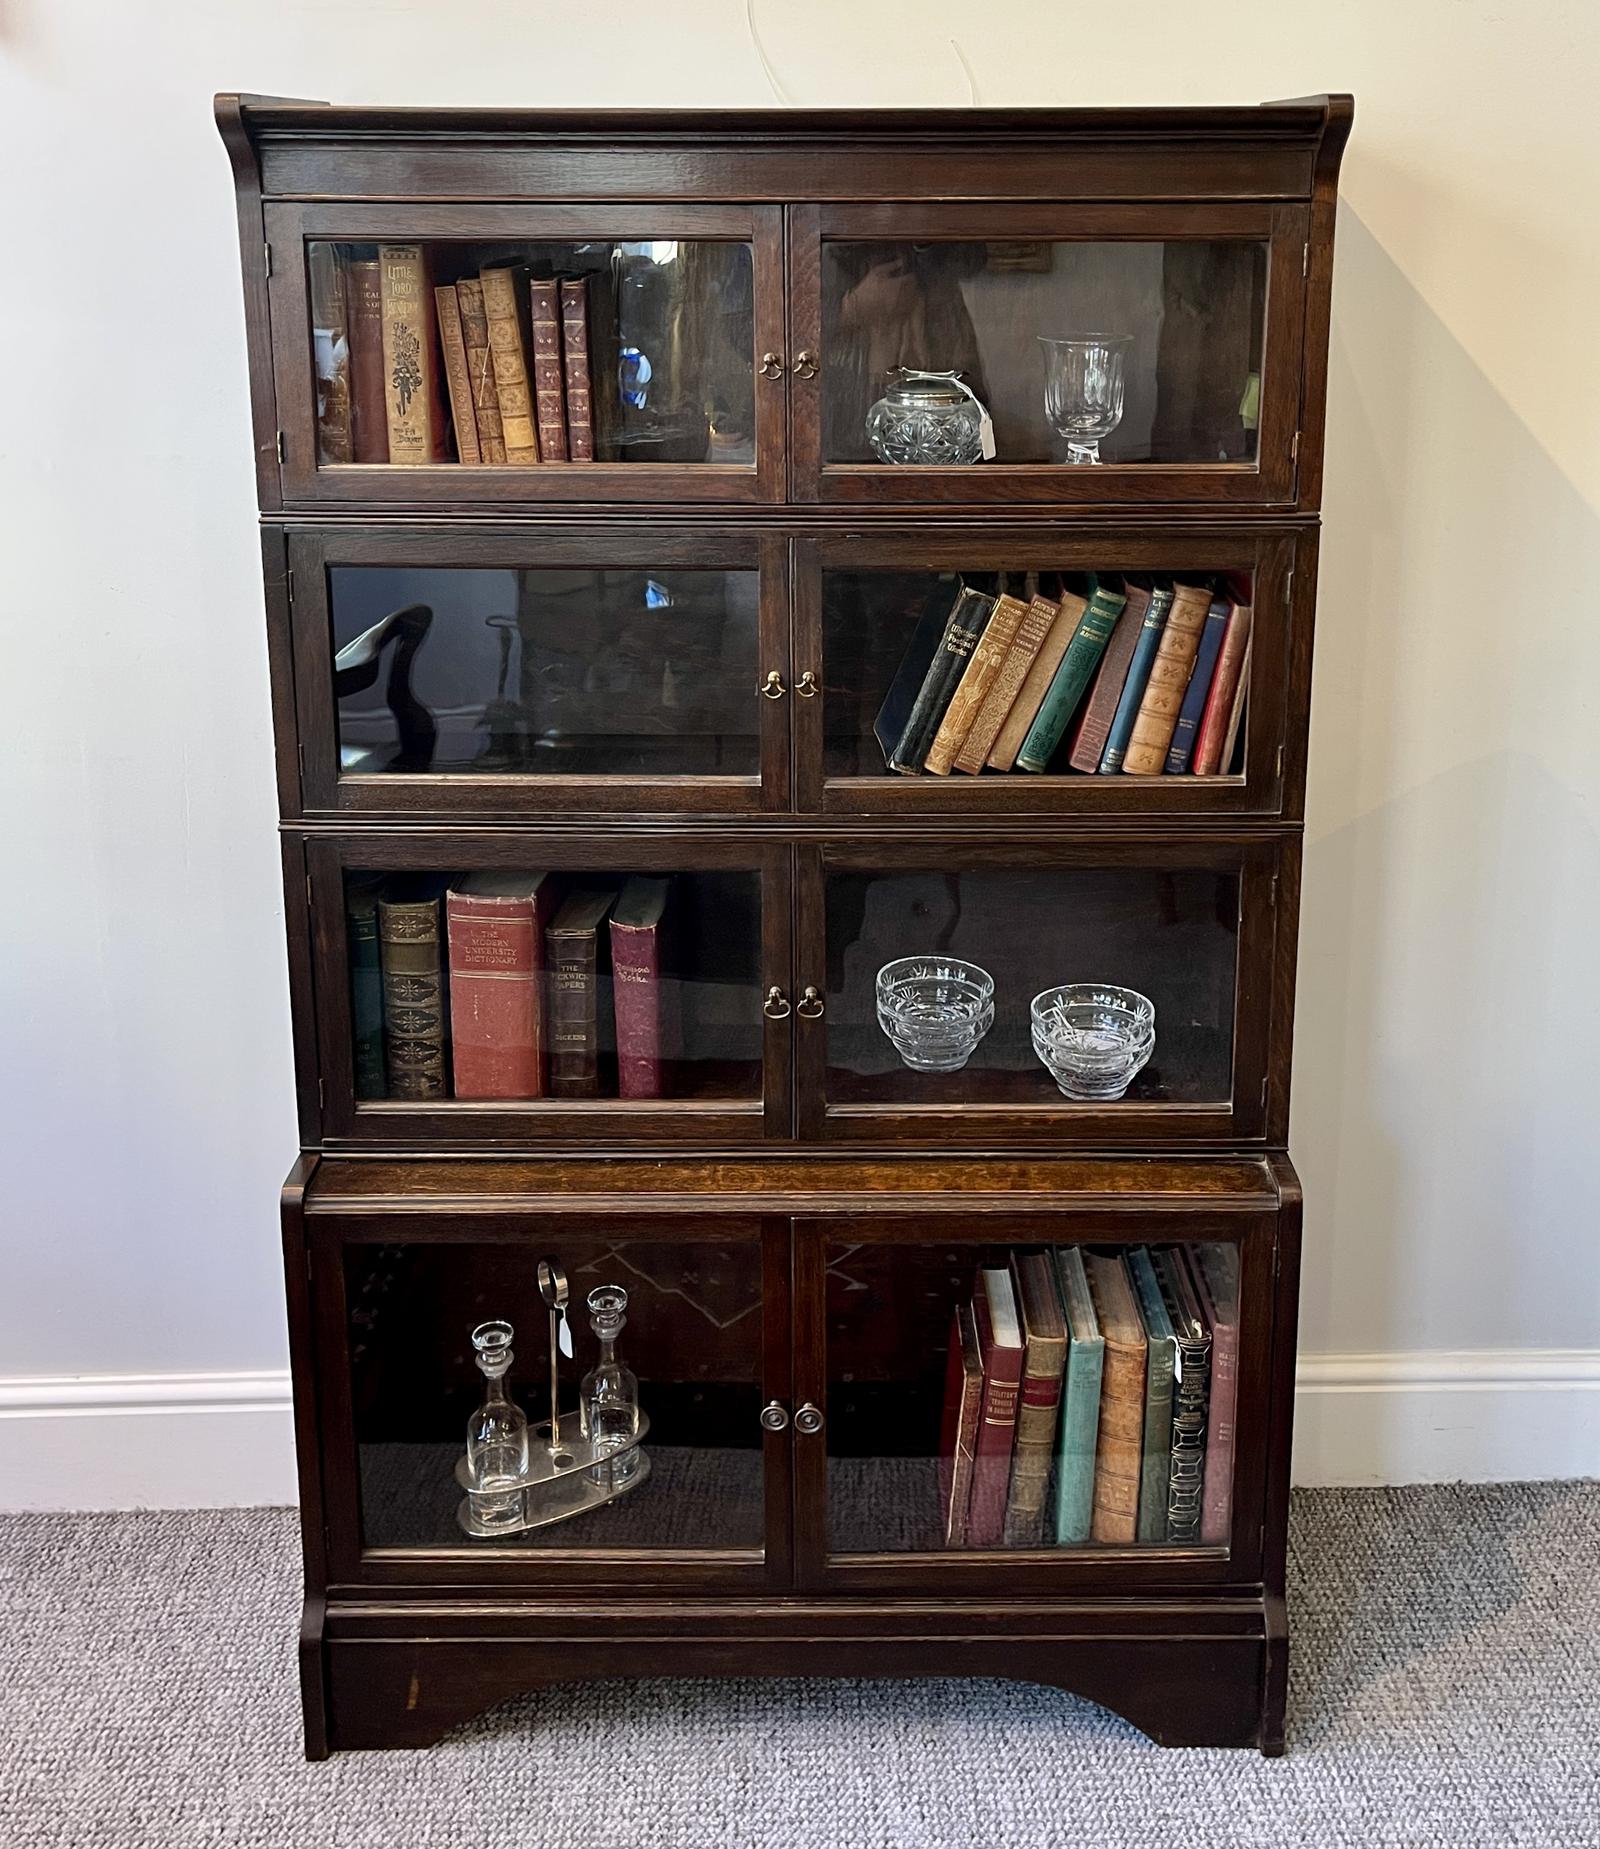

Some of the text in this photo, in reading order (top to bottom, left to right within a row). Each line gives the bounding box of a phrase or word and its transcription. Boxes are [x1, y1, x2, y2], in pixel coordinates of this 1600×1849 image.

[391, 281, 412, 298] LORD
[471, 939, 510, 947] MODERN
[464, 946, 518, 957] UNIVERSITY
[464, 955, 518, 965] DICTIONARY
[561, 964, 579, 972] THE
[551, 972, 590, 981] CKWICK
